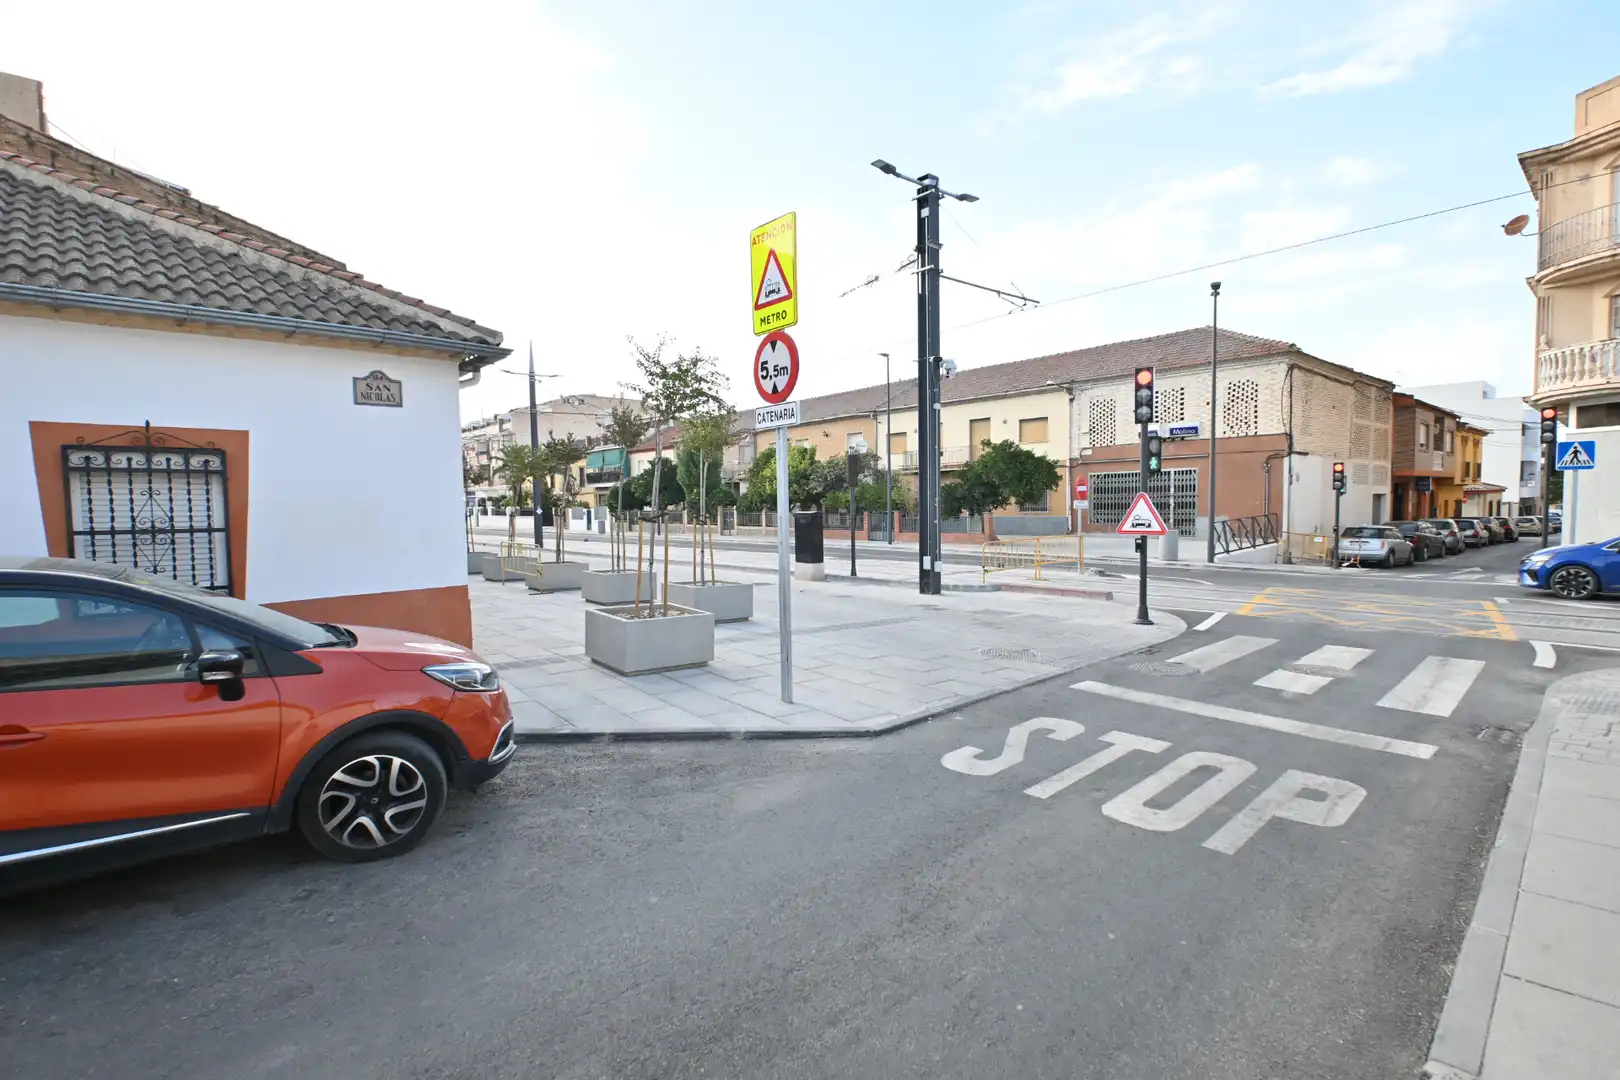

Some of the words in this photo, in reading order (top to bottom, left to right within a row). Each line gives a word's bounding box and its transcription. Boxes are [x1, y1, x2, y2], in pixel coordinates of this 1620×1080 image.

[760, 309, 787, 327] METRO
[760, 360, 789, 381] 5,5m
[365, 382, 391, 392] SAN
[757, 407, 796, 424] CATENARIA
[940, 717, 1367, 854] STOP
